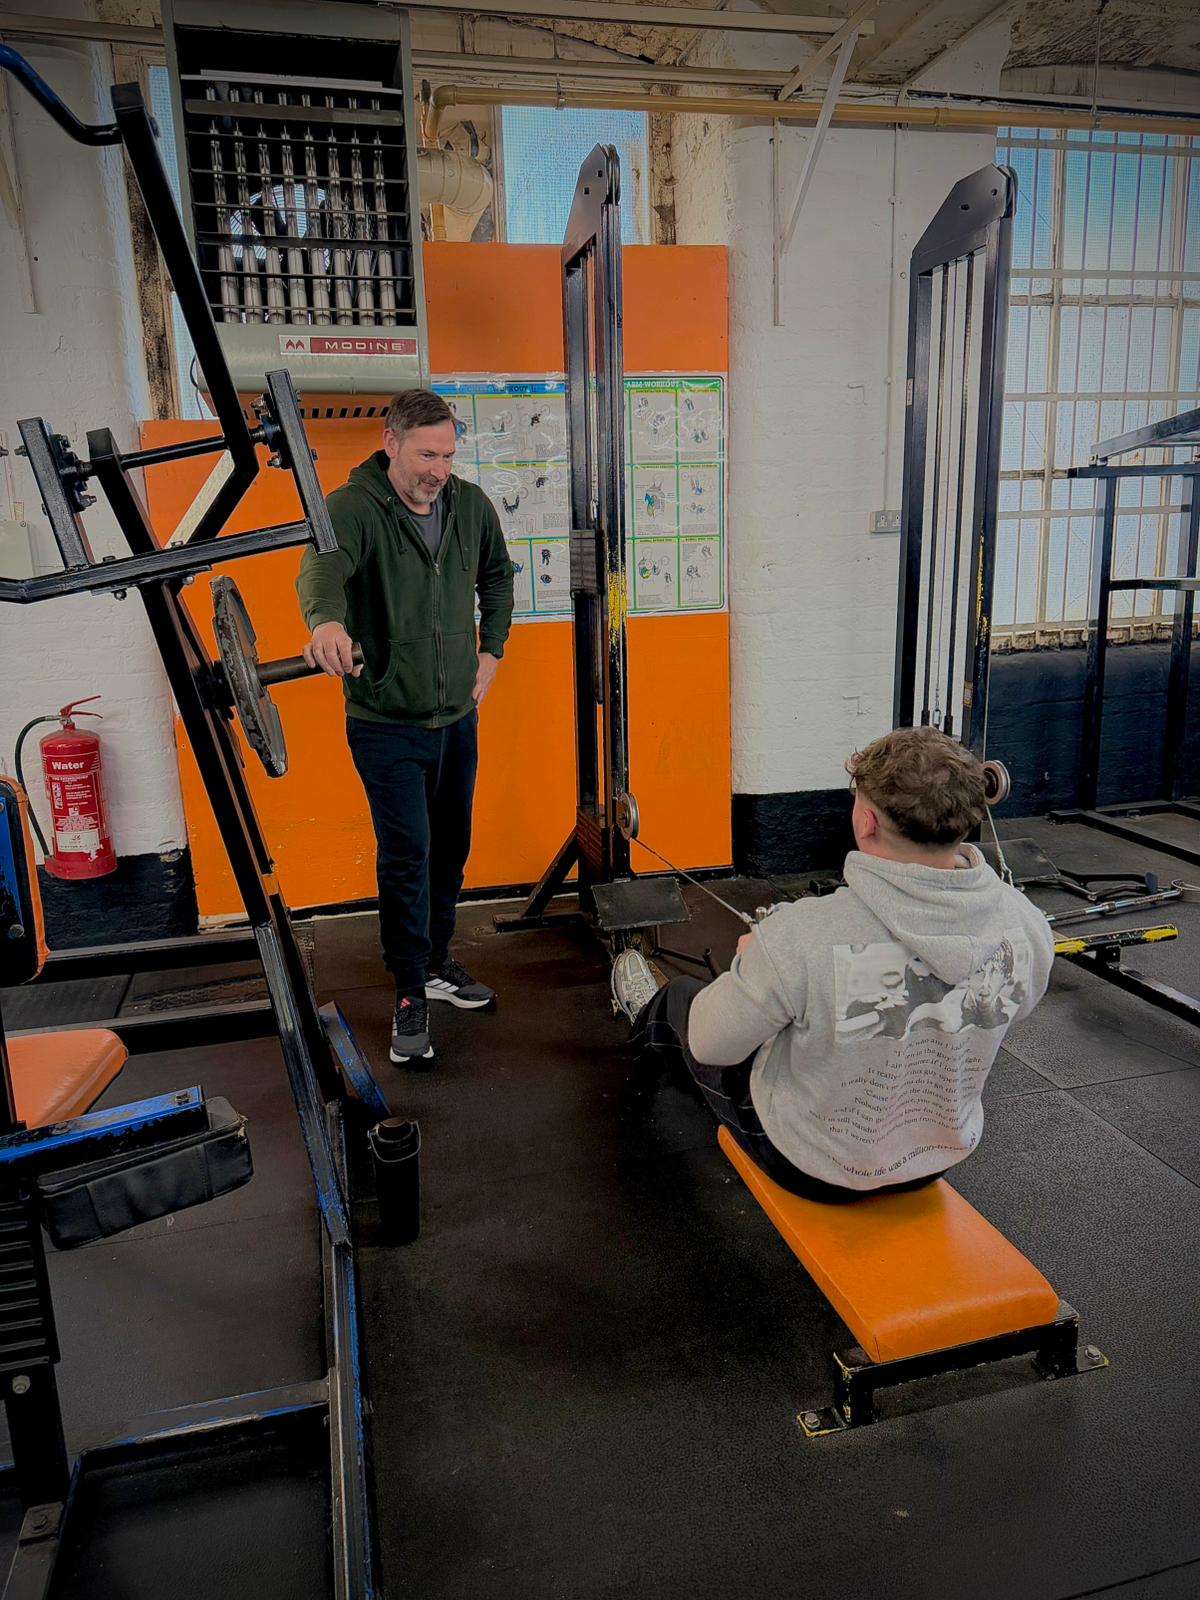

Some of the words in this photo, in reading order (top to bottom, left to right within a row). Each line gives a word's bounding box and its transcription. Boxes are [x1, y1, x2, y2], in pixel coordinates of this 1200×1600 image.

[325, 341, 403, 351] MODINE
[51, 761, 85, 770] Water
[877, 1070, 898, 1081] really
[842, 1164, 873, 1177] whole
[874, 1166, 887, 1177] life
[888, 1161, 903, 1173] was
[902, 1156, 908, 1164] a
